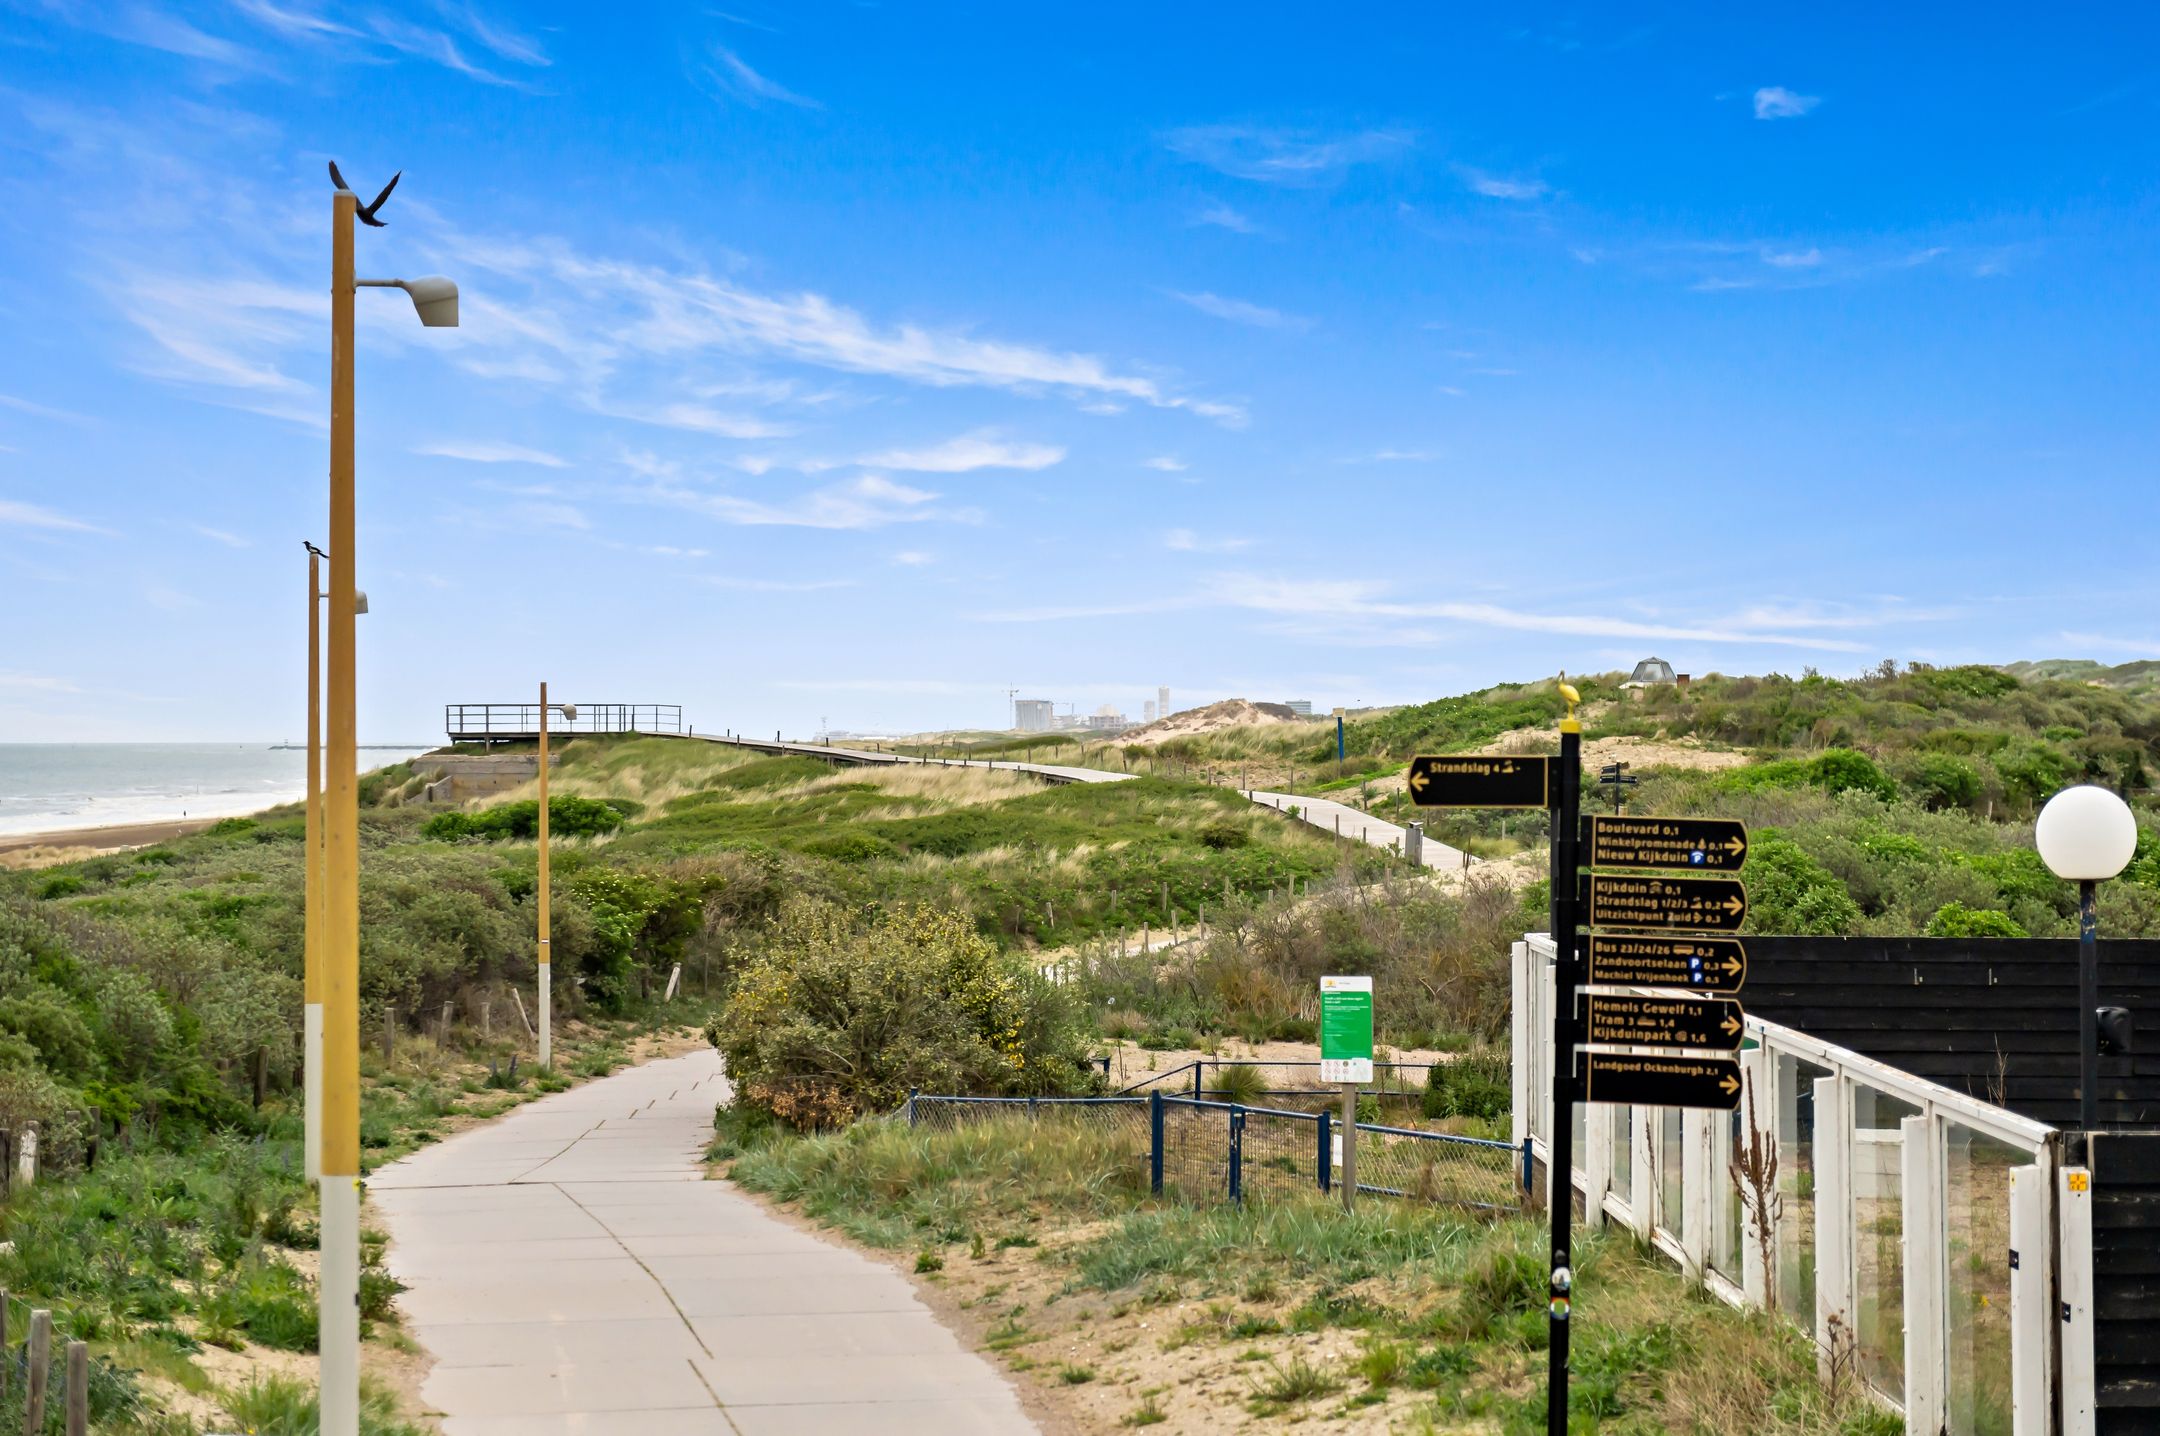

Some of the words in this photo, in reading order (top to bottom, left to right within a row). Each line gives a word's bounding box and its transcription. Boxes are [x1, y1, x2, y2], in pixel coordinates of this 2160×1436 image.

[1430, 762, 1490, 775] Strandslag
[1493, 764, 1500, 773] 4
[1598, 823, 1659, 835] Boulevard
[1597, 837, 1695, 849] Winkelpromenade
[1597, 849, 1634, 860] Nieuw
[1638, 850, 1689, 863] Kijkduin
[1596, 881, 1647, 895] Kijkduin
[1596, 895, 1658, 909] Strandslag
[1662, 898, 1688, 909] 1/2/3
[1596, 910, 1663, 922] Uitzichtpunt
[1667, 911, 1691, 922] Zuid
[1595, 941, 1617, 953] Bus
[1620, 943, 1670, 955] 23/24/26
[1595, 955, 1687, 969] Zandvoortselaan
[1595, 970, 1633, 980] Machiel
[1635, 971, 1689, 983] Vrijenhoek
[1594, 1001, 1639, 1013] Hemels
[1642, 1002, 1685, 1015] Gewelf
[1594, 1014, 1624, 1025] Tram
[1593, 1028, 1672, 1042] Kijkduinpark
[1594, 1060, 1641, 1073] Landgoed
[1643, 1063, 1704, 1076] Ockenburgh
